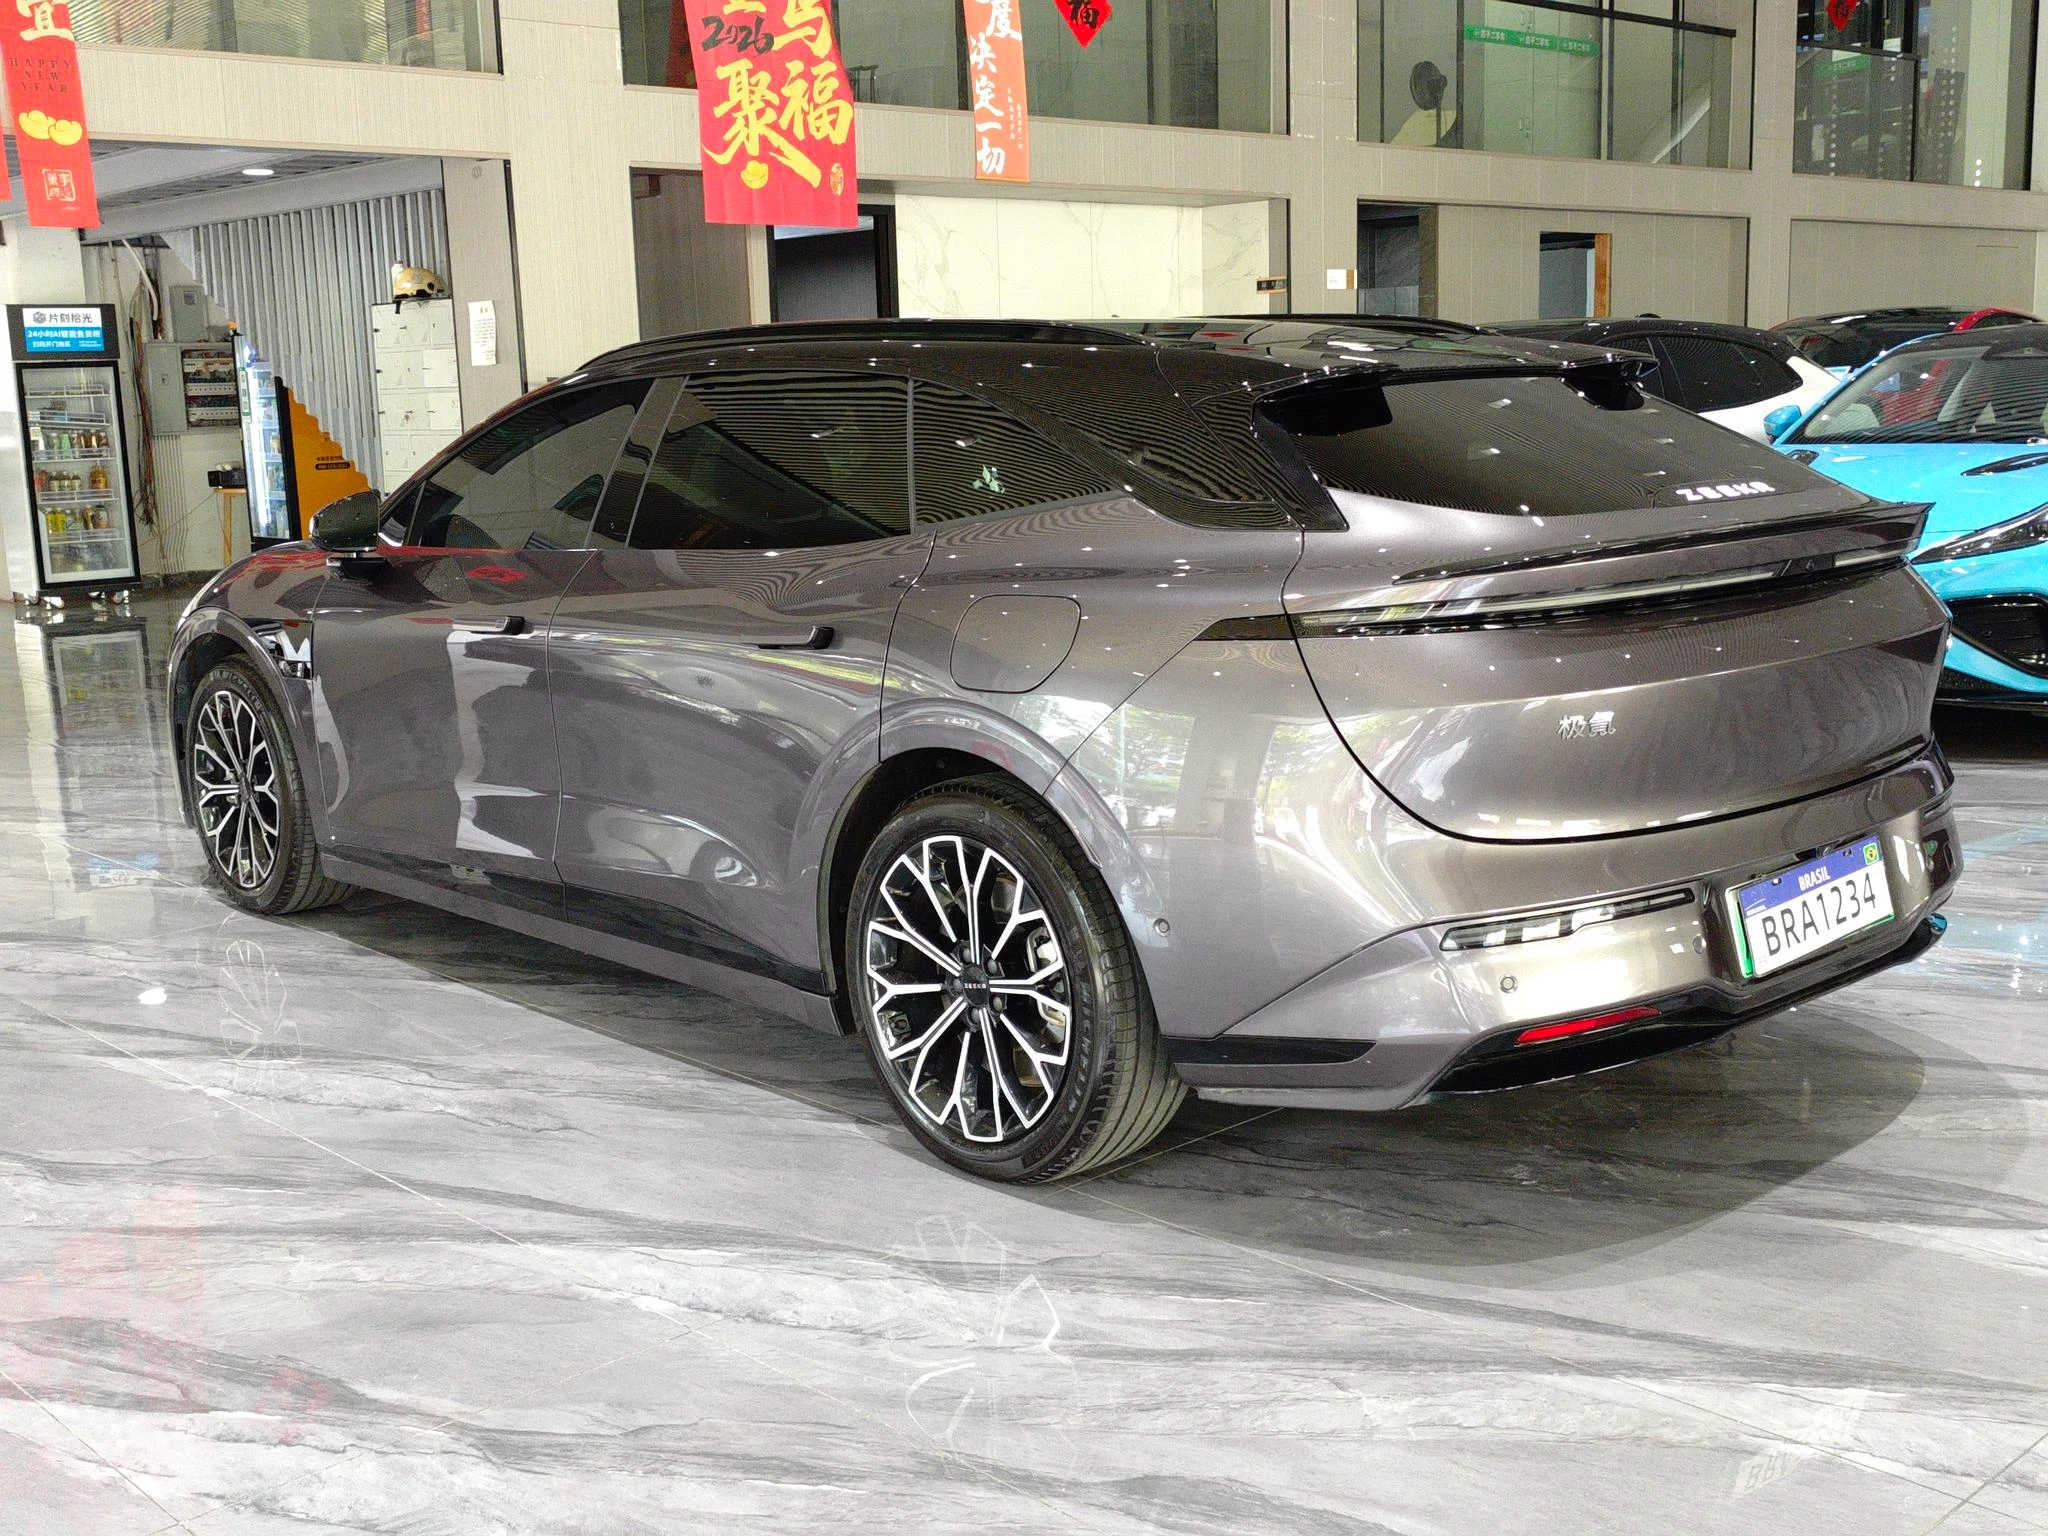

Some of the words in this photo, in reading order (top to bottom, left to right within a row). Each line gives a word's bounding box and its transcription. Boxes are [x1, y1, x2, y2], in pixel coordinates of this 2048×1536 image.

[702, 15, 775, 55] 2026
[10, 57, 71, 69] HAPPY
[25, 71, 59, 80] NEW
[21, 81, 68, 93] YEAR
[969, 0, 1023, 175] 度决定一切
[702, 58, 853, 189] 聚福
[48, 312, 94, 324] 片刻拾光
[1557, 710, 1617, 740] 极氪
[1798, 866, 1831, 891] BRASIL
[1761, 872, 1876, 957] BRA1234
